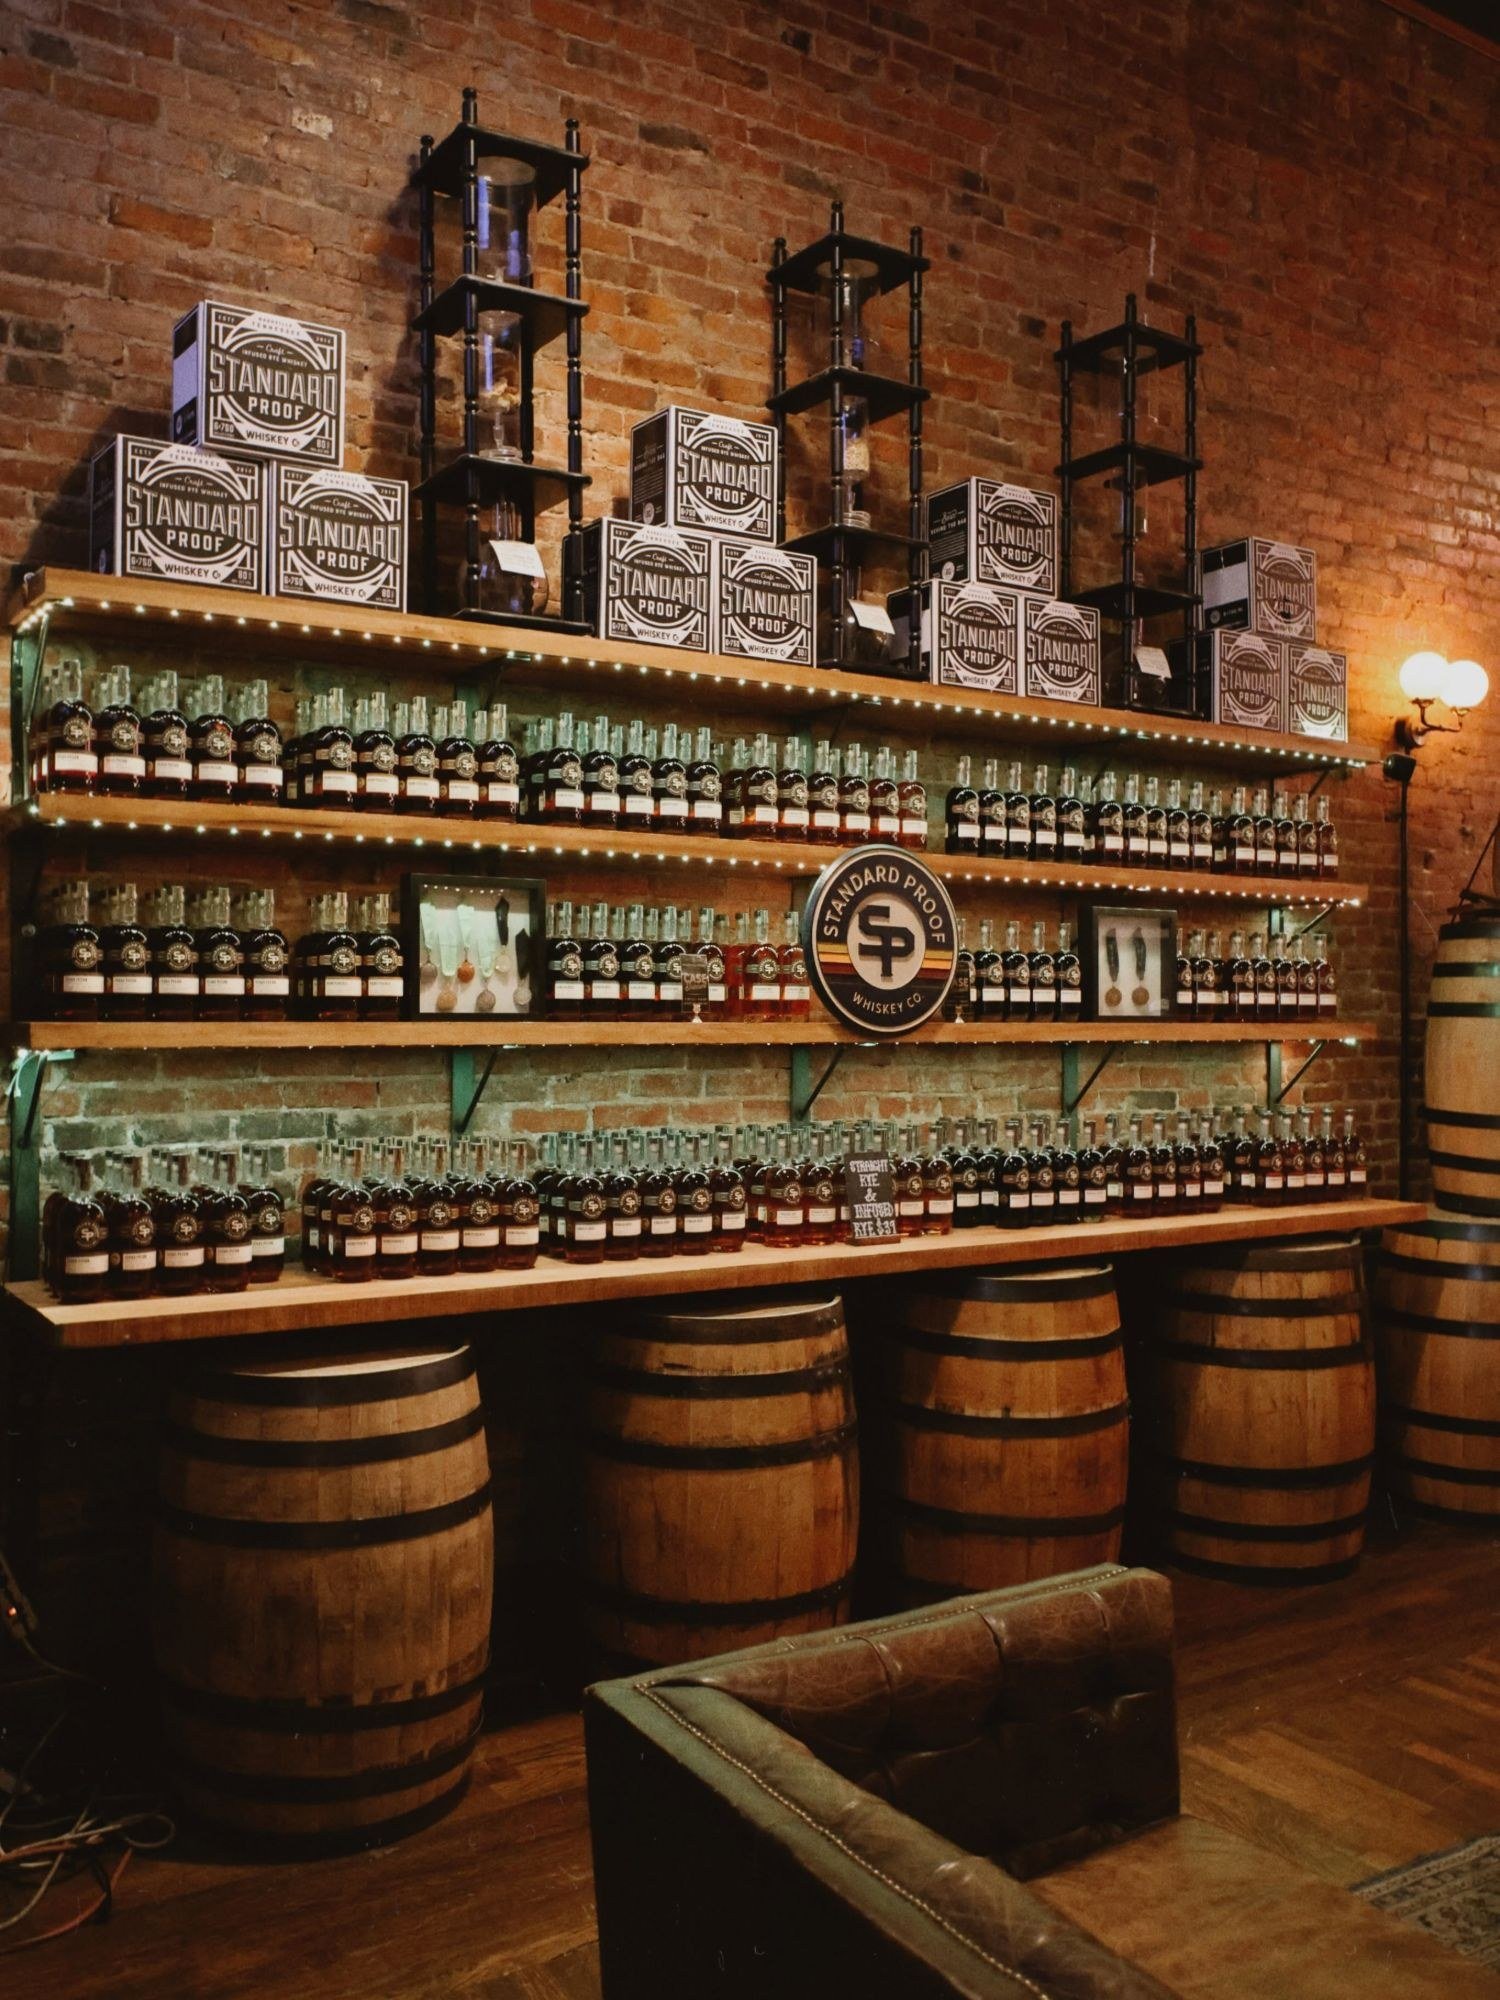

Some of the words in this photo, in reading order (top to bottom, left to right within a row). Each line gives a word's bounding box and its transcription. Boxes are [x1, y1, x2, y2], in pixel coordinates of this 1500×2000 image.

[242, 349, 267, 359] INFUSED
[281, 357, 307, 366] WHISKEY
[265, 344, 284, 355] Craft
[209, 348, 336, 415] STANDARD
[248, 396, 303, 420] PROOF
[245, 430, 288, 444] WHISKEY
[184, 475, 203, 487] Craft
[677, 446, 771, 500] STANDARD
[159, 482, 185, 491] INFUSED
[201, 489, 227, 497] WHISKEY
[706, 485, 746, 505] PROOF
[310, 504, 334, 513] INFUSED
[348, 510, 372, 518] WHISKEY
[332, 498, 350, 509] Craft
[126, 482, 258, 546] STANDARD
[704, 514, 736, 525] WHISKEY
[166, 529, 224, 552] PROOF
[279, 505, 400, 565] STANDARD
[978, 511, 1052, 559] STANDARD
[316, 549, 369, 571] PROOF
[1001, 546, 1033, 563] PROOF
[164, 563, 209, 577] WHISKEY
[1000, 571, 1025, 581] WHISKEY
[314, 583, 355, 595] WHISKEY
[609, 559, 707, 612] STANDARD
[638, 598, 681, 618] PROOF
[722, 578, 811, 628] STANDARD
[749, 616, 788, 633] PROOF
[636, 628, 670, 639] WHISKEY
[940, 614, 1015, 660] STANDARD
[747, 644, 778, 654] WHISKEY
[963, 649, 996, 665] PROOF
[1027, 629, 1096, 672] STANDARD
[1048, 662, 1078, 678] PROOF
[962, 675, 988, 684] WHISKEY
[1221, 661, 1280, 700] STANDARD
[1047, 688, 1071, 696] WHISKEY
[1239, 691, 1264, 705] PROOF
[1290, 673, 1345, 712] STANDARD
[1307, 703, 1331, 717] PROOF
[824, 865, 900, 937] STANDARD
[904, 874, 945, 943] PROOF
[858, 905, 914, 976] SP
[684, 973, 708, 984] CASE
[852, 992, 903, 1014] WHISKEY
[849, 1159, 888, 1172] STRAIGHT
[859, 1173, 880, 1186] RYE
[865, 1188, 877, 1202] &
[854, 1202, 894, 1218] INFUSED
[853, 1221, 876, 1236] RYE
